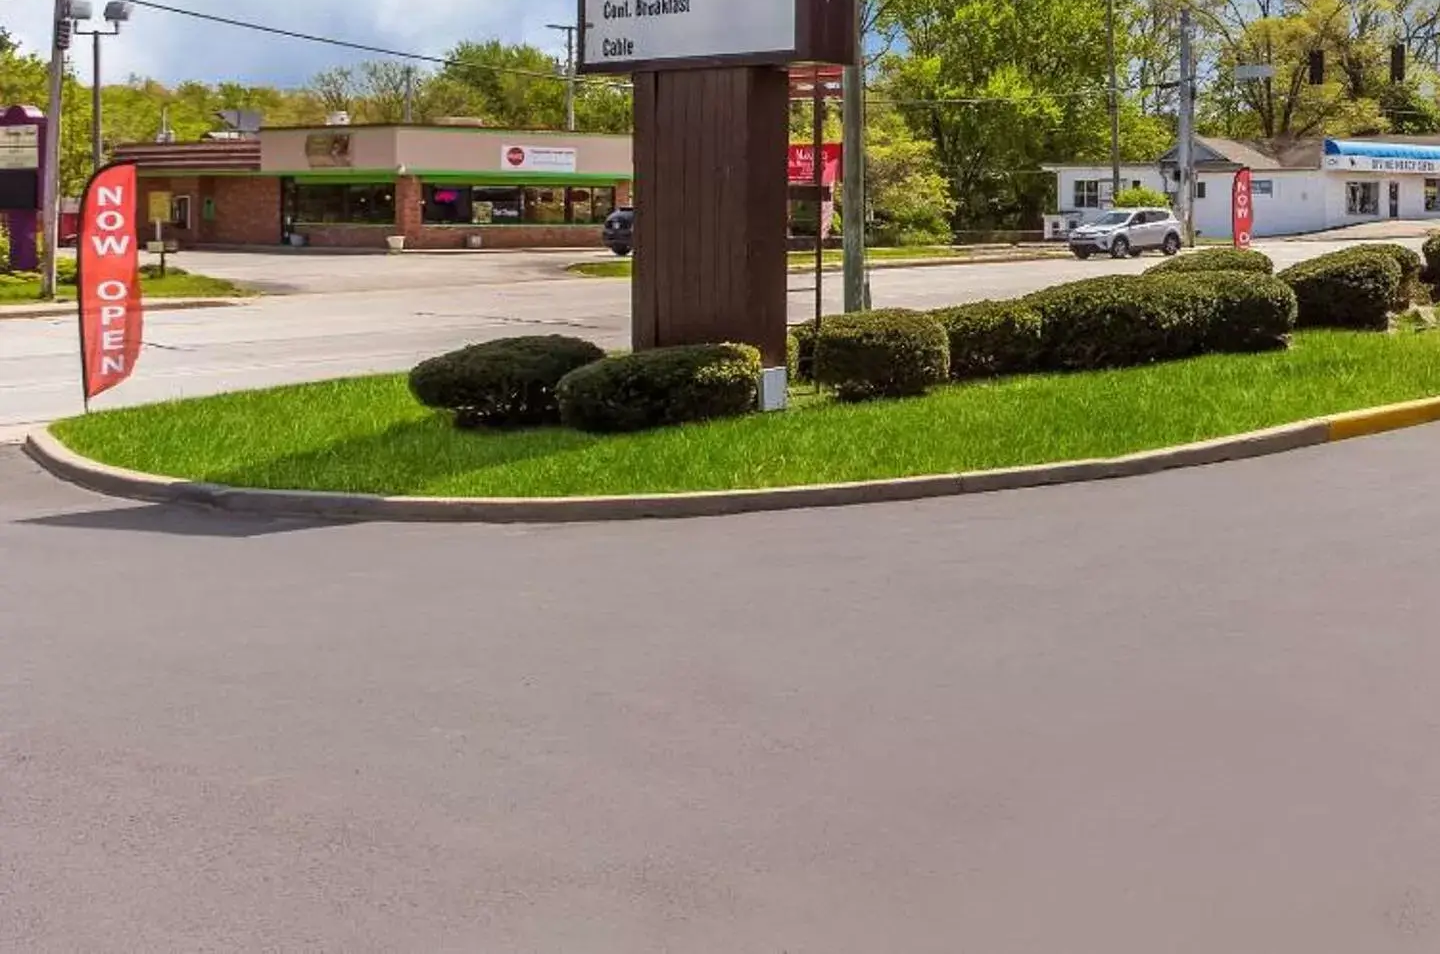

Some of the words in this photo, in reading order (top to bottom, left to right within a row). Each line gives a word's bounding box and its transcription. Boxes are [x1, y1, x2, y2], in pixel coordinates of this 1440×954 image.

[602, 37, 635, 57] Cable
[92, 185, 130, 255] NOW
[96, 279, 127, 376] OPEN
